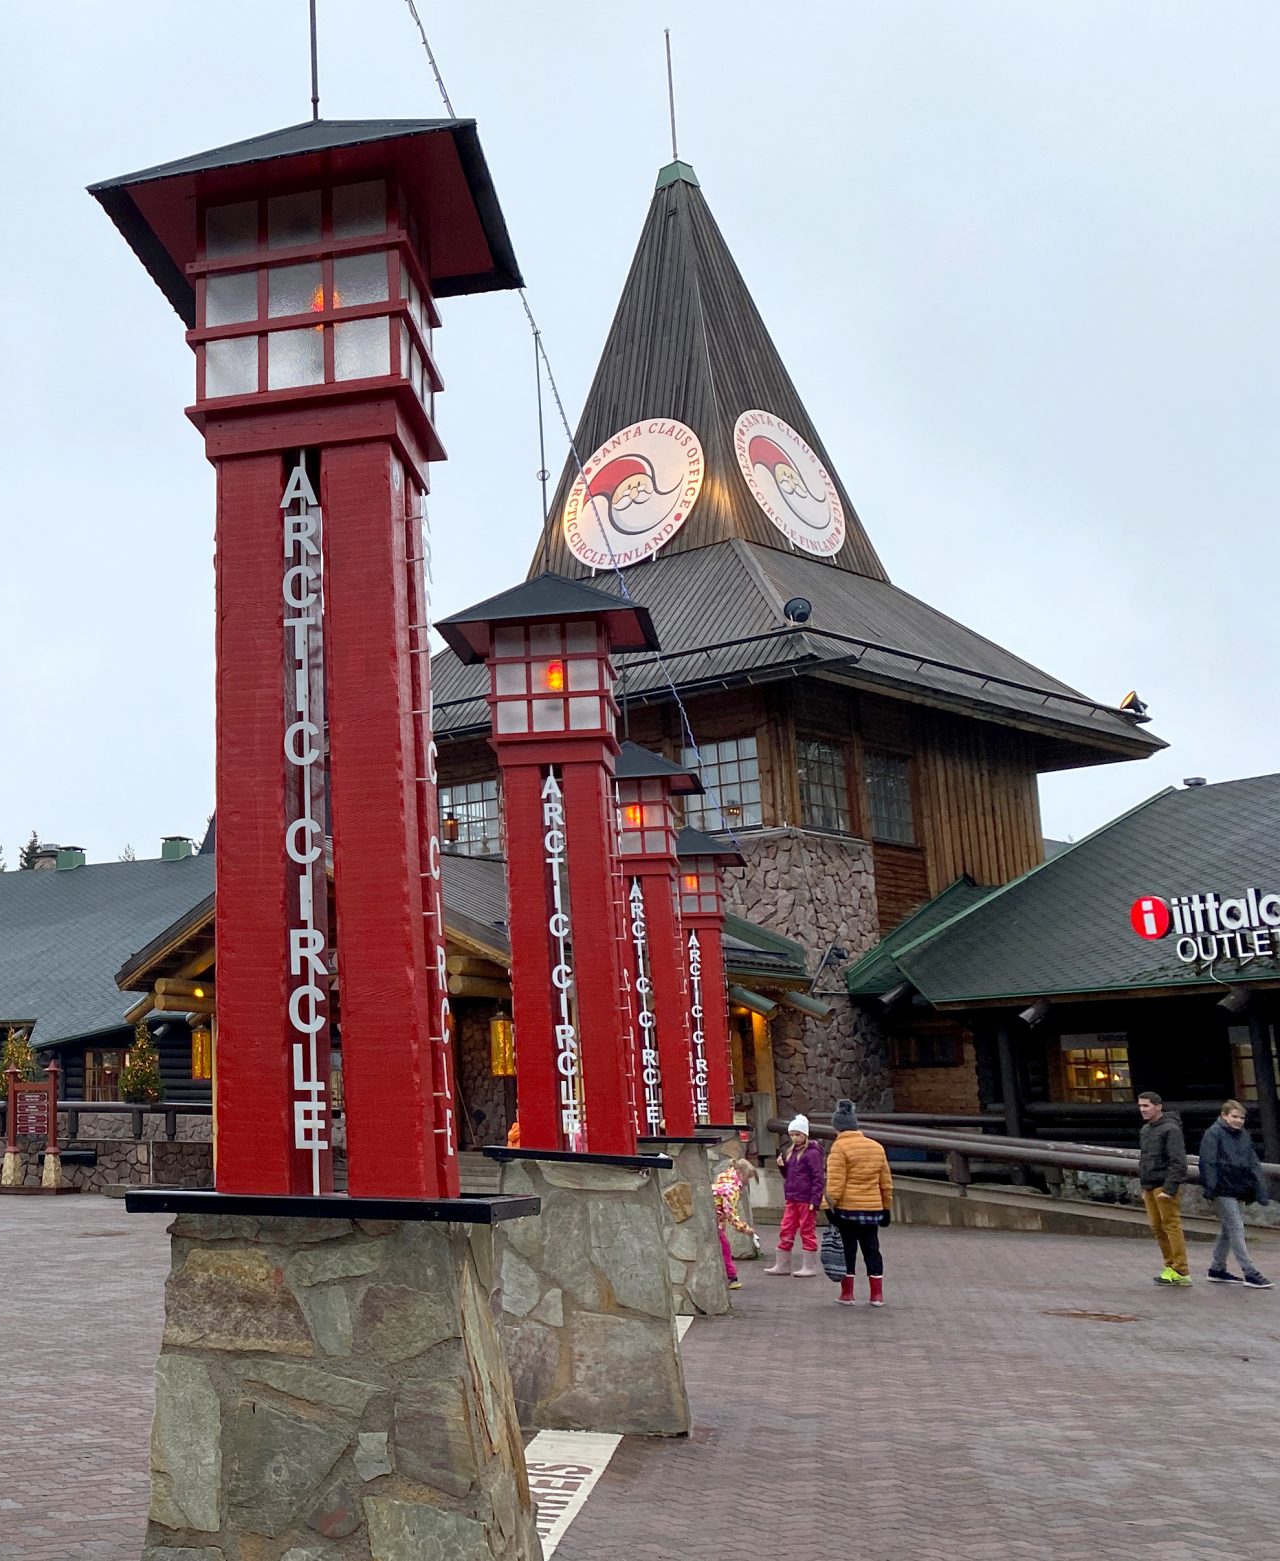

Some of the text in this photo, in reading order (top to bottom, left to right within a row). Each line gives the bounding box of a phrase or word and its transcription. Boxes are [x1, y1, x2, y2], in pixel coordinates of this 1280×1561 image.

[566, 476, 674, 565] ARCTIC CIRCLE FINLAND
[592, 422, 700, 509] SANTA CLAUS OFFICE
[736, 433, 840, 552] ARCTIC CIRCLE FINLAND
[743, 413, 842, 528] SANTA CLAUS OFFICE
[279, 466, 329, 1150] ARCTIC CIRCLE
[541, 775, 579, 1134] ARCTIC CIRCLE
[629, 883, 650, 994] ARCTIC
[688, 935, 703, 1018] ARCTIC
[639, 1011, 659, 1123] CIRCLE
[692, 1031, 708, 1116] CIRCLE
